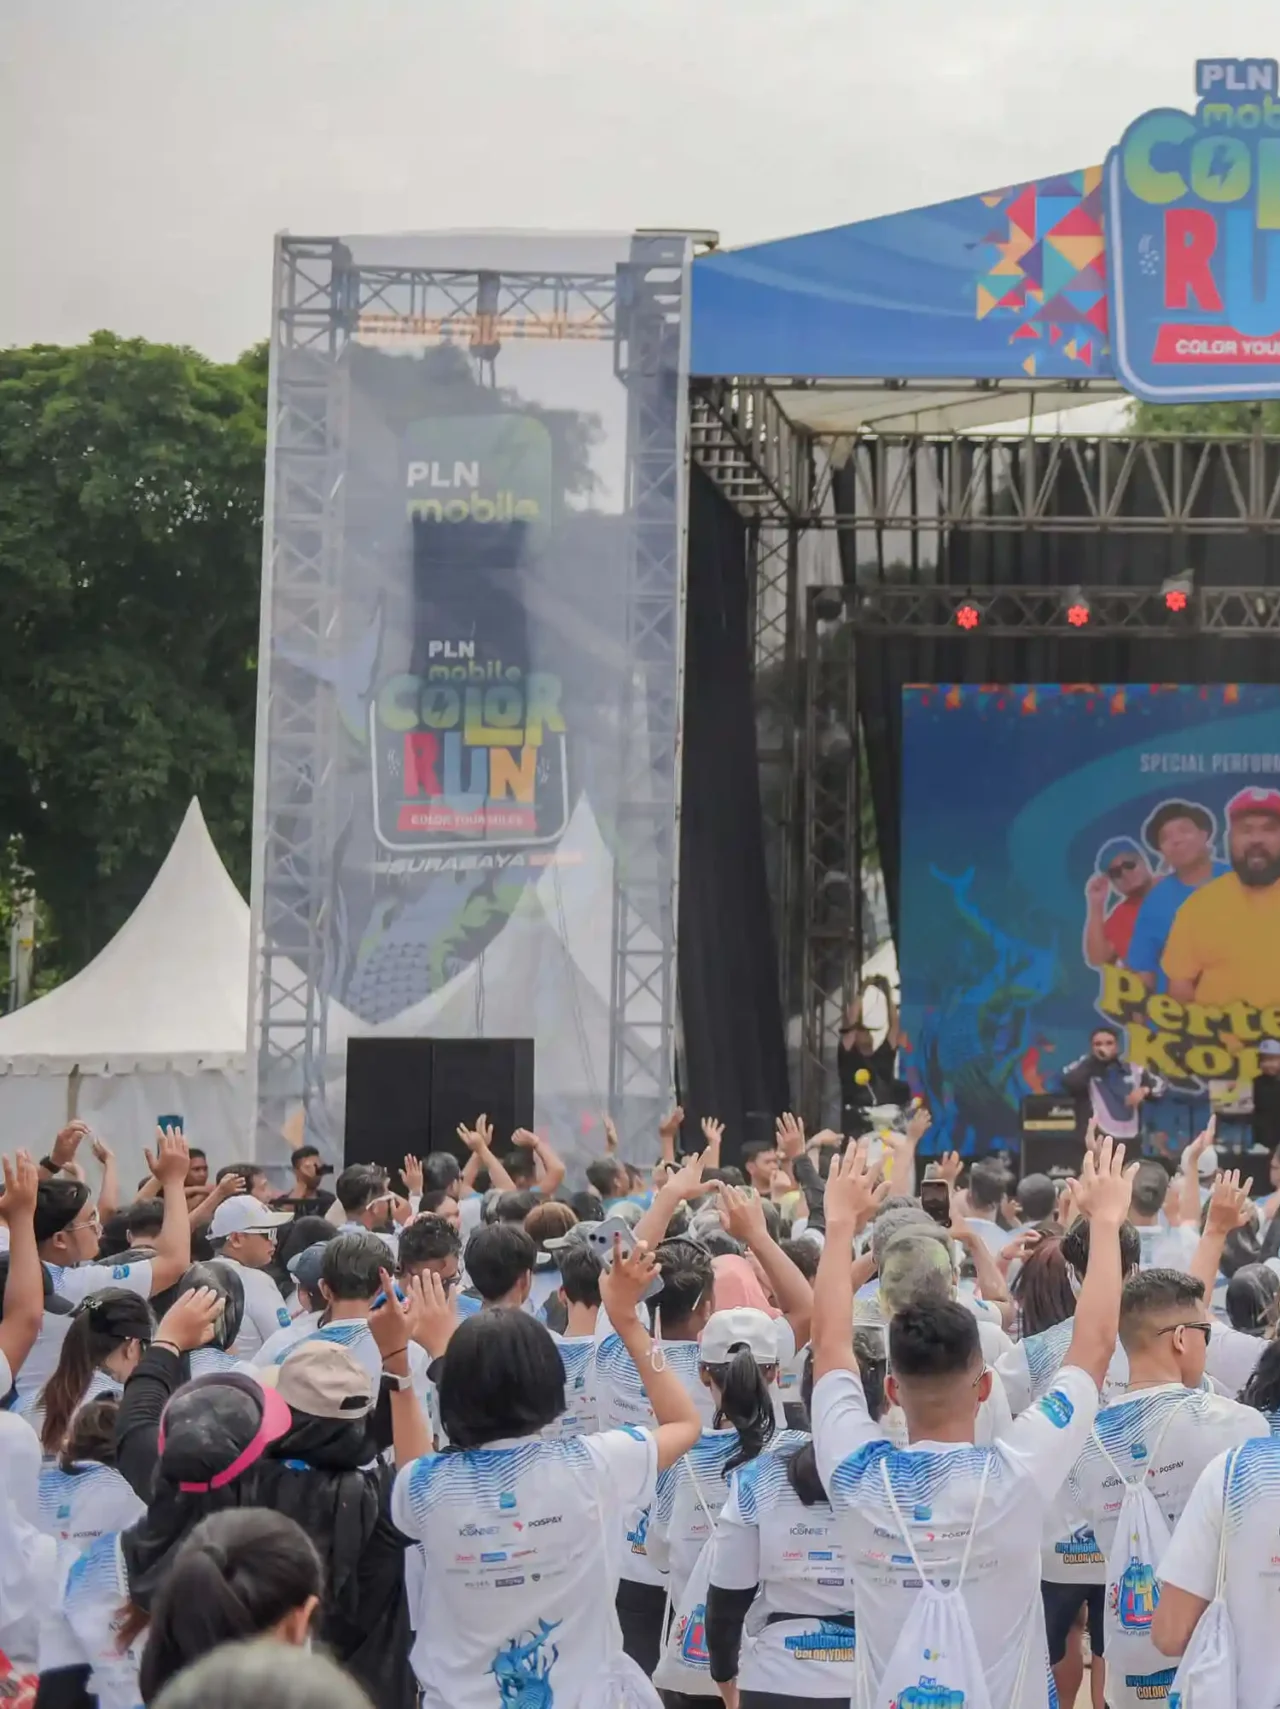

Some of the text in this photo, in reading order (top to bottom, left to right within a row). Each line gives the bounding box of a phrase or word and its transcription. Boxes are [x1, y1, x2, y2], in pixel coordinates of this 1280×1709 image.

[1202, 65, 1272, 90] PLN
[1175, 339, 1237, 355] COLOR
[407, 461, 479, 488] PLN
[406, 490, 539, 524] mobile
[428, 641, 475, 658] PLN
[429, 661, 522, 681] mobile
[379, 673, 567, 746] COLOR
[403, 731, 541, 813] RUN
[1140, 753, 1205, 773] SPECIAL
[1159, 1461, 1185, 1473] POSPAY
[528, 1515, 563, 1528] POSPAY
